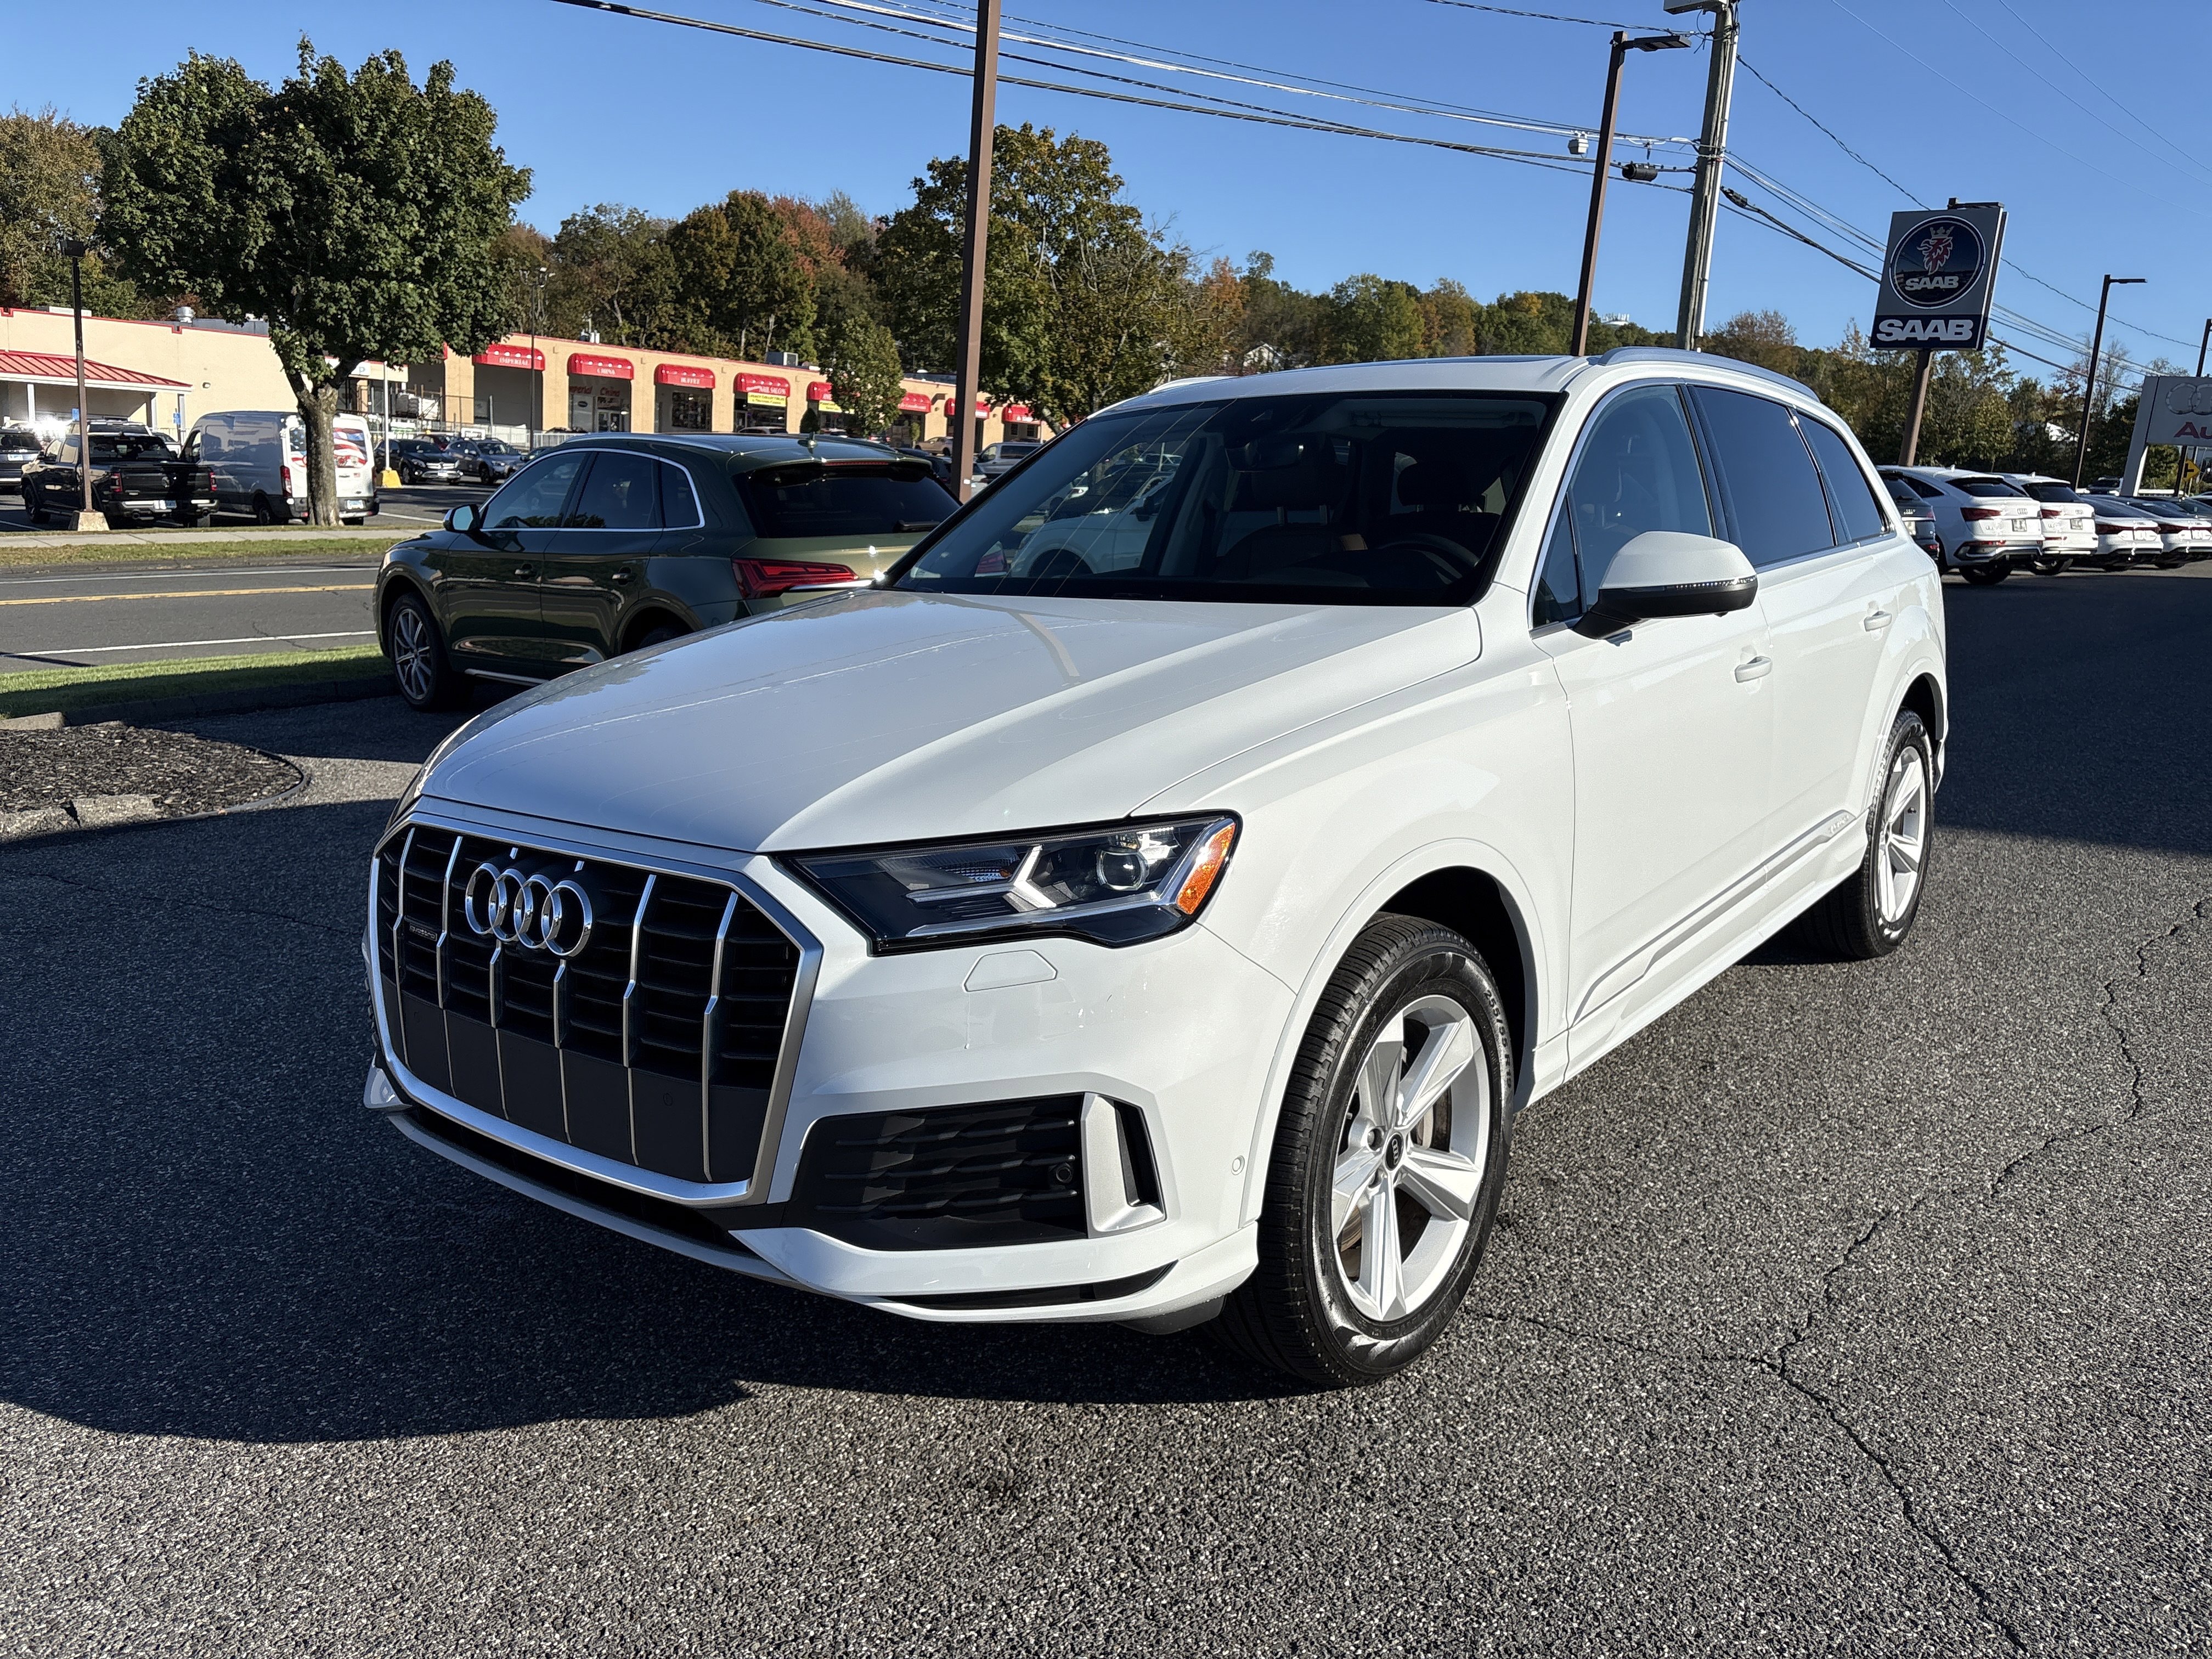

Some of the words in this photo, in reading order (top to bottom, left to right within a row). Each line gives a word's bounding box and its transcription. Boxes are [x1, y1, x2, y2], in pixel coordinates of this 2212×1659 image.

[1905, 276, 1959, 291] SAAB
[1876, 319, 1974, 341] SAAB
[1483, 990, 1508, 1047] 255/55
